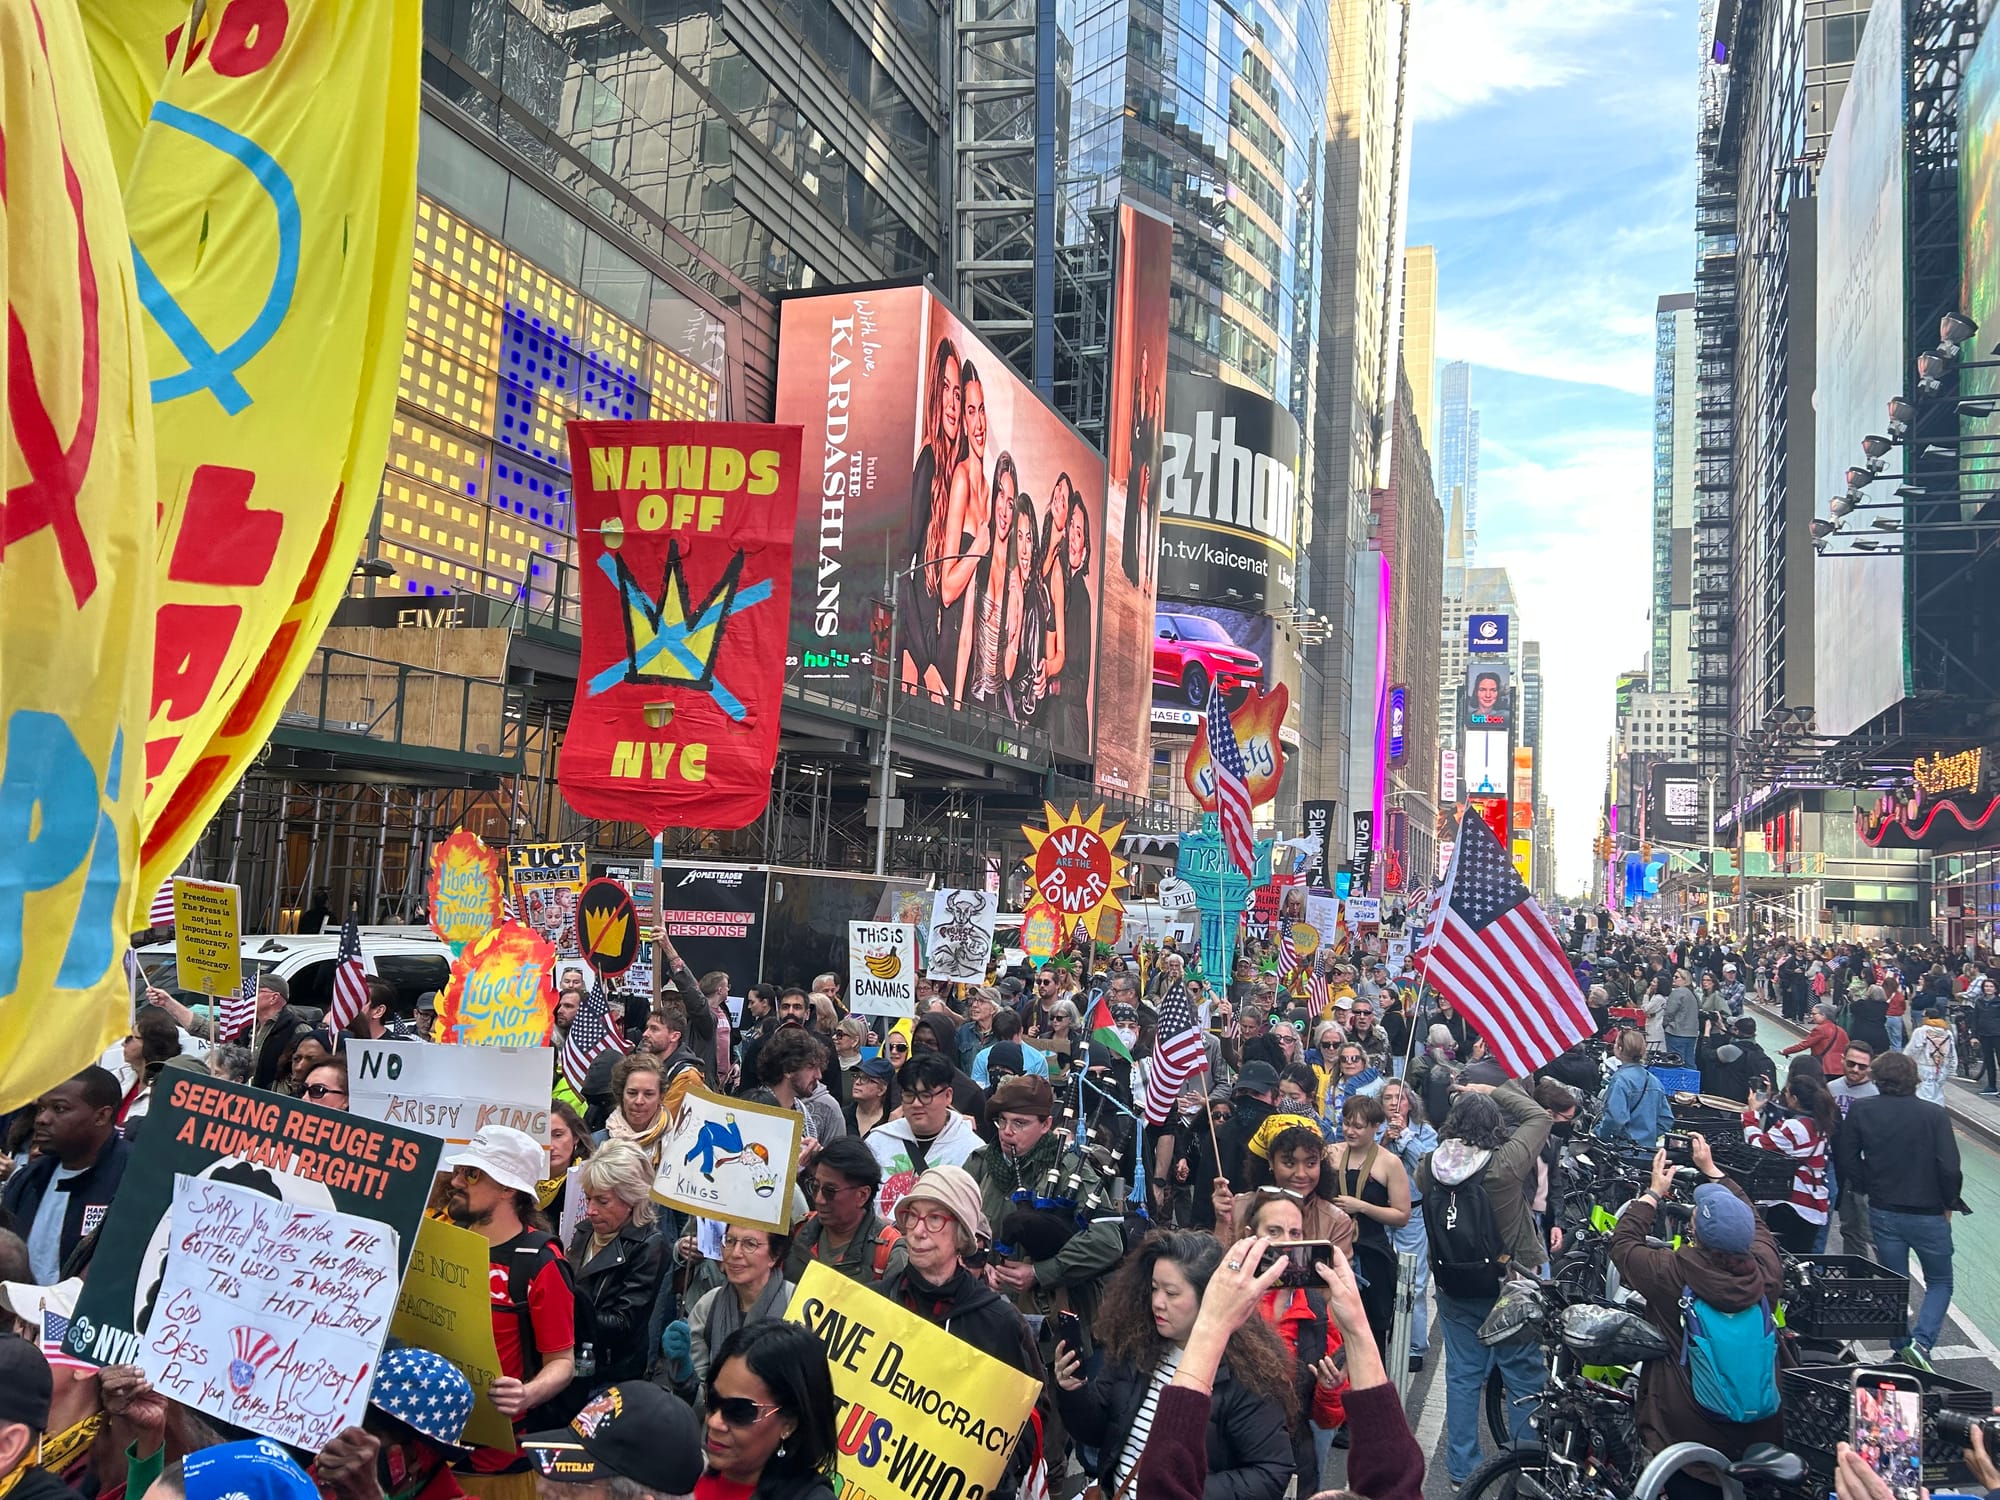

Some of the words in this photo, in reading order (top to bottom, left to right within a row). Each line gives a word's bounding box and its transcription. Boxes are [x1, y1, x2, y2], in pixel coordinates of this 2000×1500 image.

[588, 445, 781, 495] HANDS
[815, 315, 855, 638] KARDASHIANS
[847, 451, 863, 498] THE
[865, 456, 879, 490] hulu
[1160, 410, 1295, 550] athon
[636, 494, 725, 532] OFF
[1157, 537, 1269, 577] h.tv/kaicenat
[1151, 712, 1181, 721] HASE
[1471, 714, 1504, 725] britbox
[610, 741, 708, 782] NYC
[509, 844, 585, 868] FUCK
[1050, 828, 1098, 859] WE
[517, 869, 578, 882] ISRAEL
[1056, 858, 1073, 867] ARE
[1074, 859, 1092, 869] THE
[440, 864, 490, 901] Liberty
[677, 869, 743, 888] HOMESTEADER
[1039, 867, 1107, 912] POWER
[182, 892, 218, 904] Freedom
[219, 898, 228, 906] of
[182, 902, 197, 912] The
[199, 904, 221, 915] Press
[222, 908, 230, 916] is
[458, 896, 489, 909] NOT
[191, 915, 204, 923] not
[205, 917, 222, 926] just
[664, 910, 752, 925] EMERGENCY
[182, 923, 222, 937] important
[224, 930, 233, 938] to
[184, 935, 230, 949] democracy,
[669, 924, 746, 938] RESPONSE
[857, 927, 890, 944] THiS
[890, 927, 904, 943] iS
[186, 956, 231, 970] democracy.
[198, 947, 205, 955] it
[207, 948, 217, 957] IS
[459, 961, 541, 1020] Liberty
[855, 978, 910, 999] BANANAS
[491, 1007, 539, 1030] NOT
[360, 1051, 403, 1080] NO
[170, 1080, 287, 1133] SEEKING
[284, 1110, 382, 1161] REFUGE
[385, 1141, 420, 1172] IS
[176, 1121, 195, 1145] A
[202, 1123, 297, 1172] HUMAN
[299, 1151, 392, 1200] RIGHT!
[676, 1173, 719, 1200] KINGS
[344, 1228, 381, 1254] THE
[430, 1255, 470, 1288] NOT
[261, 1291, 314, 1320] HAT
[802, 1297, 875, 1374] SAVE
[556, 1461, 595, 1473] VETERAN
